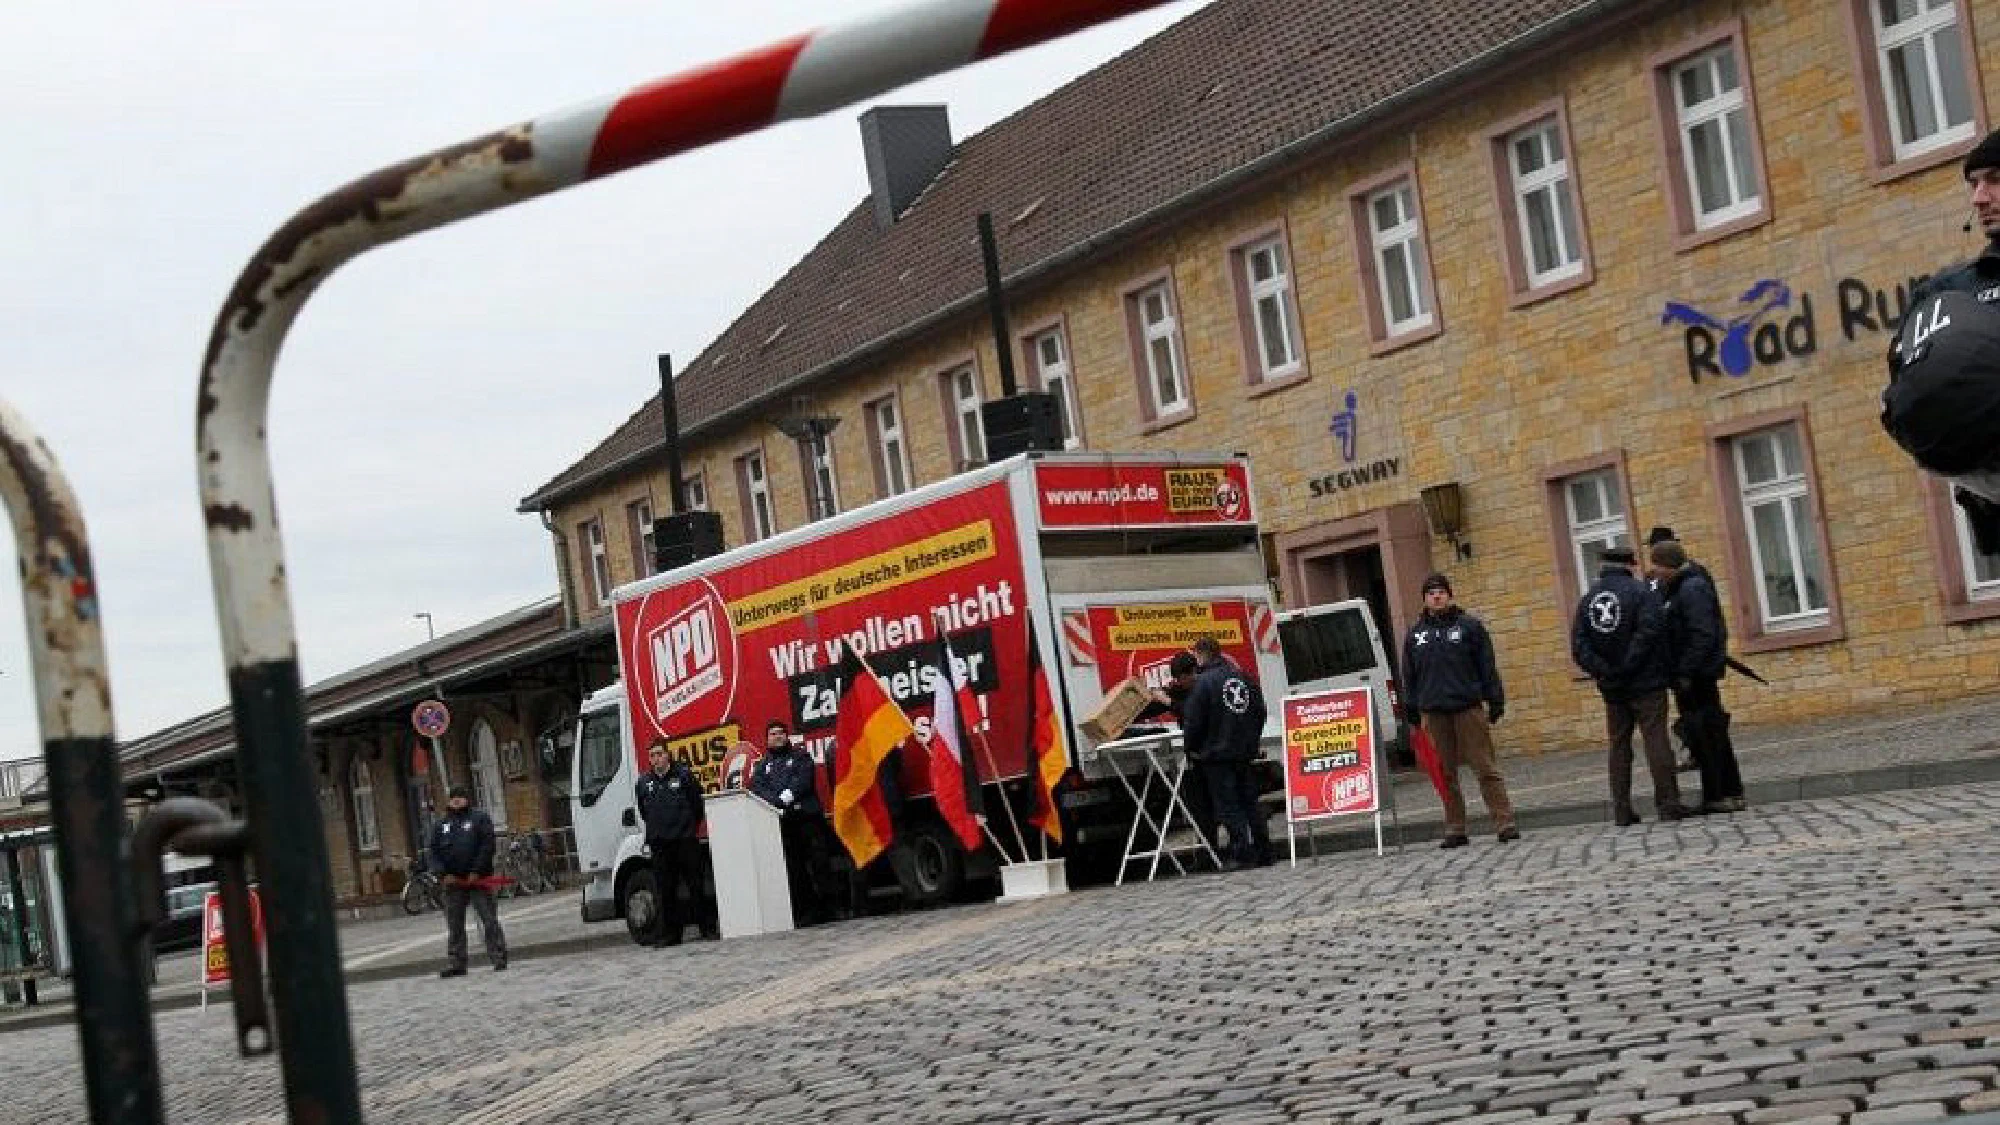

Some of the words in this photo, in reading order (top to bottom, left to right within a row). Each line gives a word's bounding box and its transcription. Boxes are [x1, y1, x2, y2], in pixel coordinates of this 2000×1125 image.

[1170, 472, 1218, 488] RAUS
[1309, 457, 1399, 497] SEGWAY
[1046, 484, 1159, 506] www.npd.de
[1172, 496, 1213, 508] EURO
[735, 593, 806, 627] Unterwegs
[809, 584, 831, 609] für
[835, 564, 901, 596] deutsche
[904, 535, 989, 573] Interessen
[1122, 607, 1187, 622] Unterwegs
[1189, 604, 1207, 617] für
[769, 637, 826, 680] Wir
[826, 613, 924, 666] wollen
[931, 579, 1015, 636] nicht
[1115, 631, 1172, 644] deutsche
[653, 609, 715, 692] NPD
[1144, 664, 1172, 689] NP
[1292, 723, 1362, 742] Gerechte
[1305, 740, 1353, 755] Löhne
[1334, 772, 1369, 800] NPD
